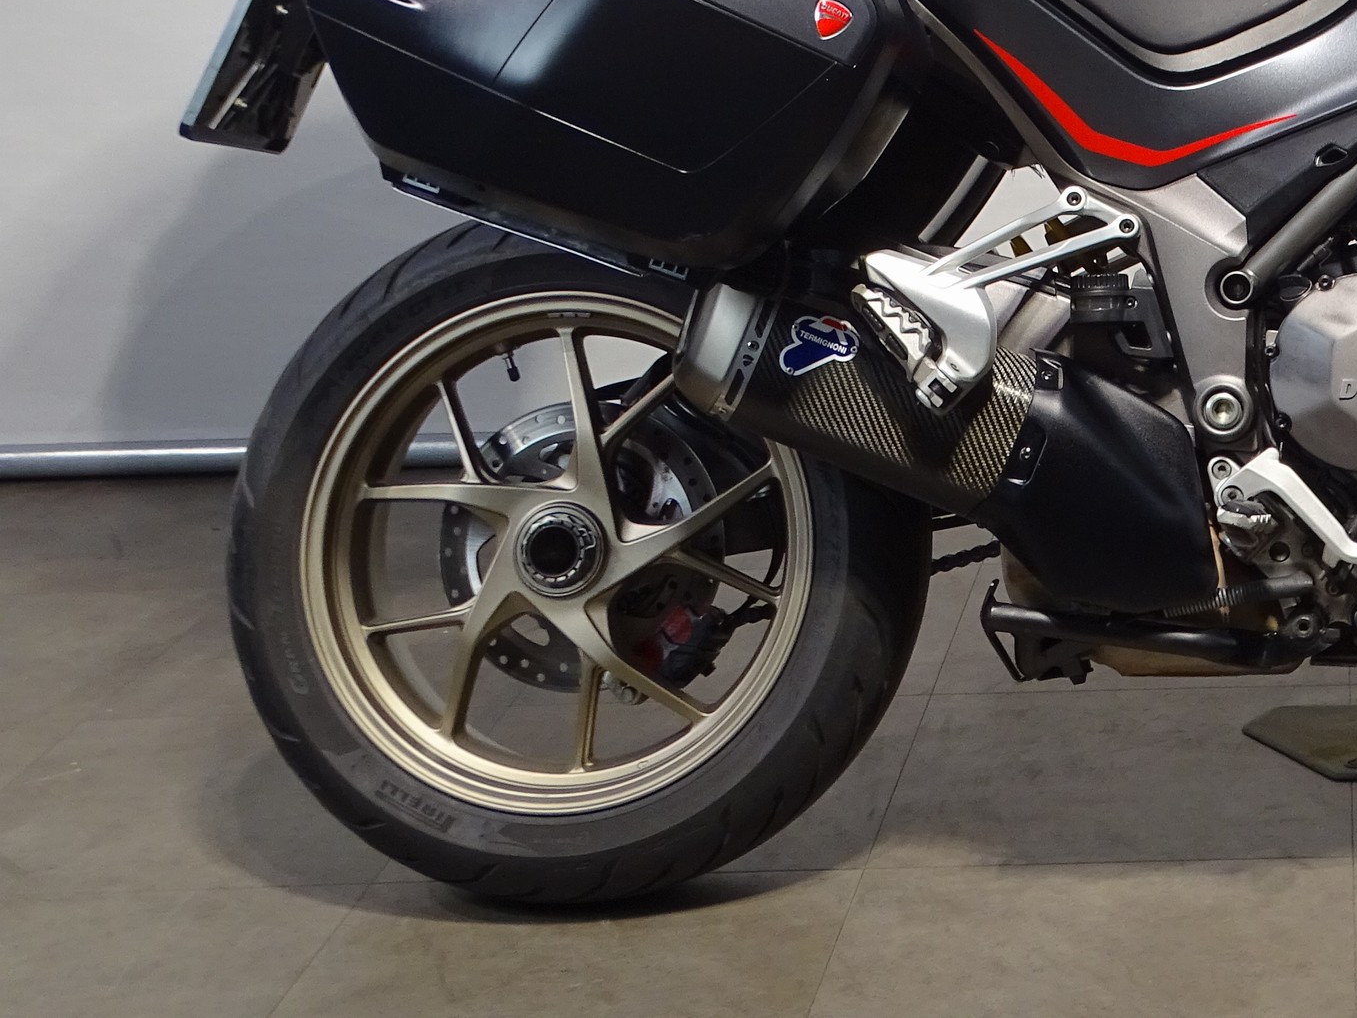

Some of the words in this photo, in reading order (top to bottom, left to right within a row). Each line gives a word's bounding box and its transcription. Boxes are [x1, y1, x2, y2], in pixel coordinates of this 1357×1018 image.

[820, 2, 849, 19] DUCATI
[800, 330, 848, 355] TERMIGNONI
[373, 779, 457, 834] PIRELLI
